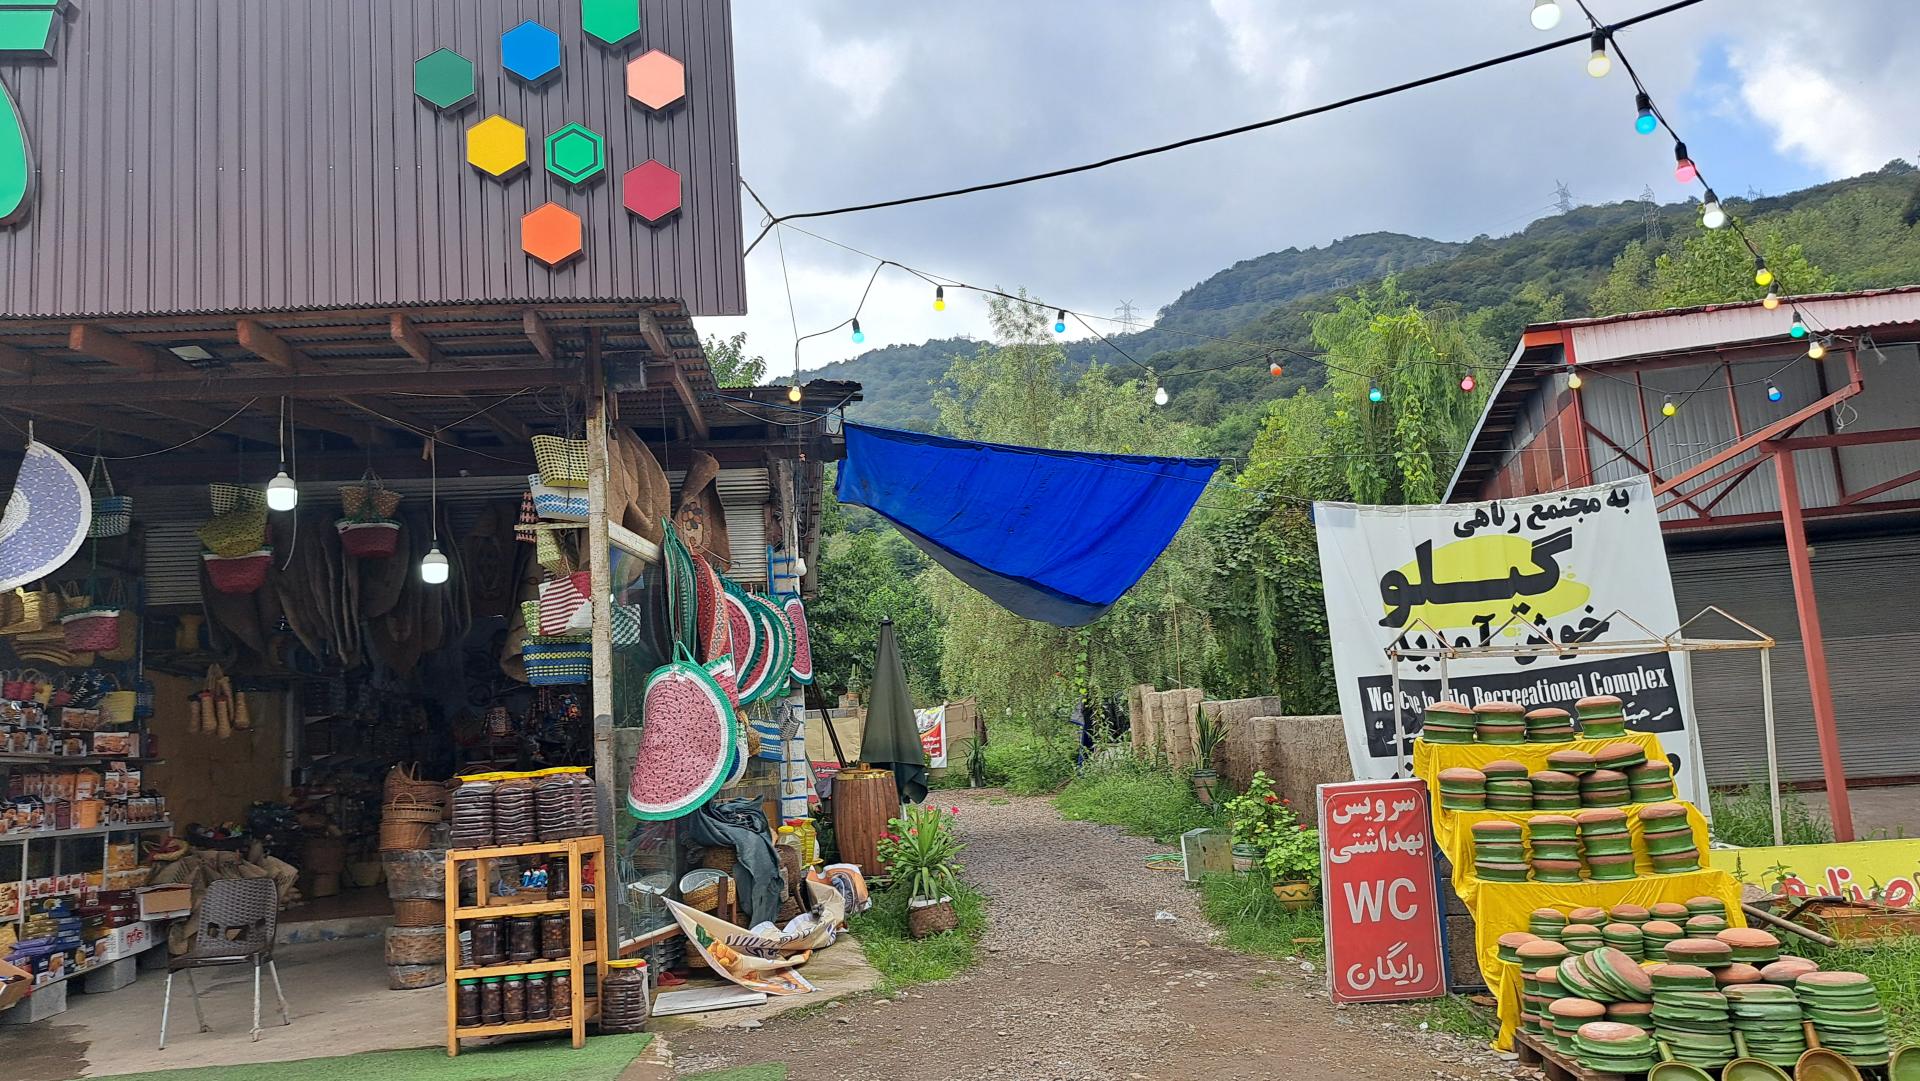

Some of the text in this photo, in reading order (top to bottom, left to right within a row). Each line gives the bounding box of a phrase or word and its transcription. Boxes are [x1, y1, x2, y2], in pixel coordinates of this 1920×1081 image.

[1526, 496, 1602, 531] مجتمع
[1606, 488, 1630, 515] به
[1378, 526, 1573, 627] گیلو
[1439, 687, 1471, 709] ilo
[1589, 665, 1669, 697] Complex
[1332, 796, 1416, 825] سرویس
[1329, 826, 1424, 864] بهداشتی
[1343, 877, 1418, 924] WC
[1346, 940, 1424, 990] رایگان
